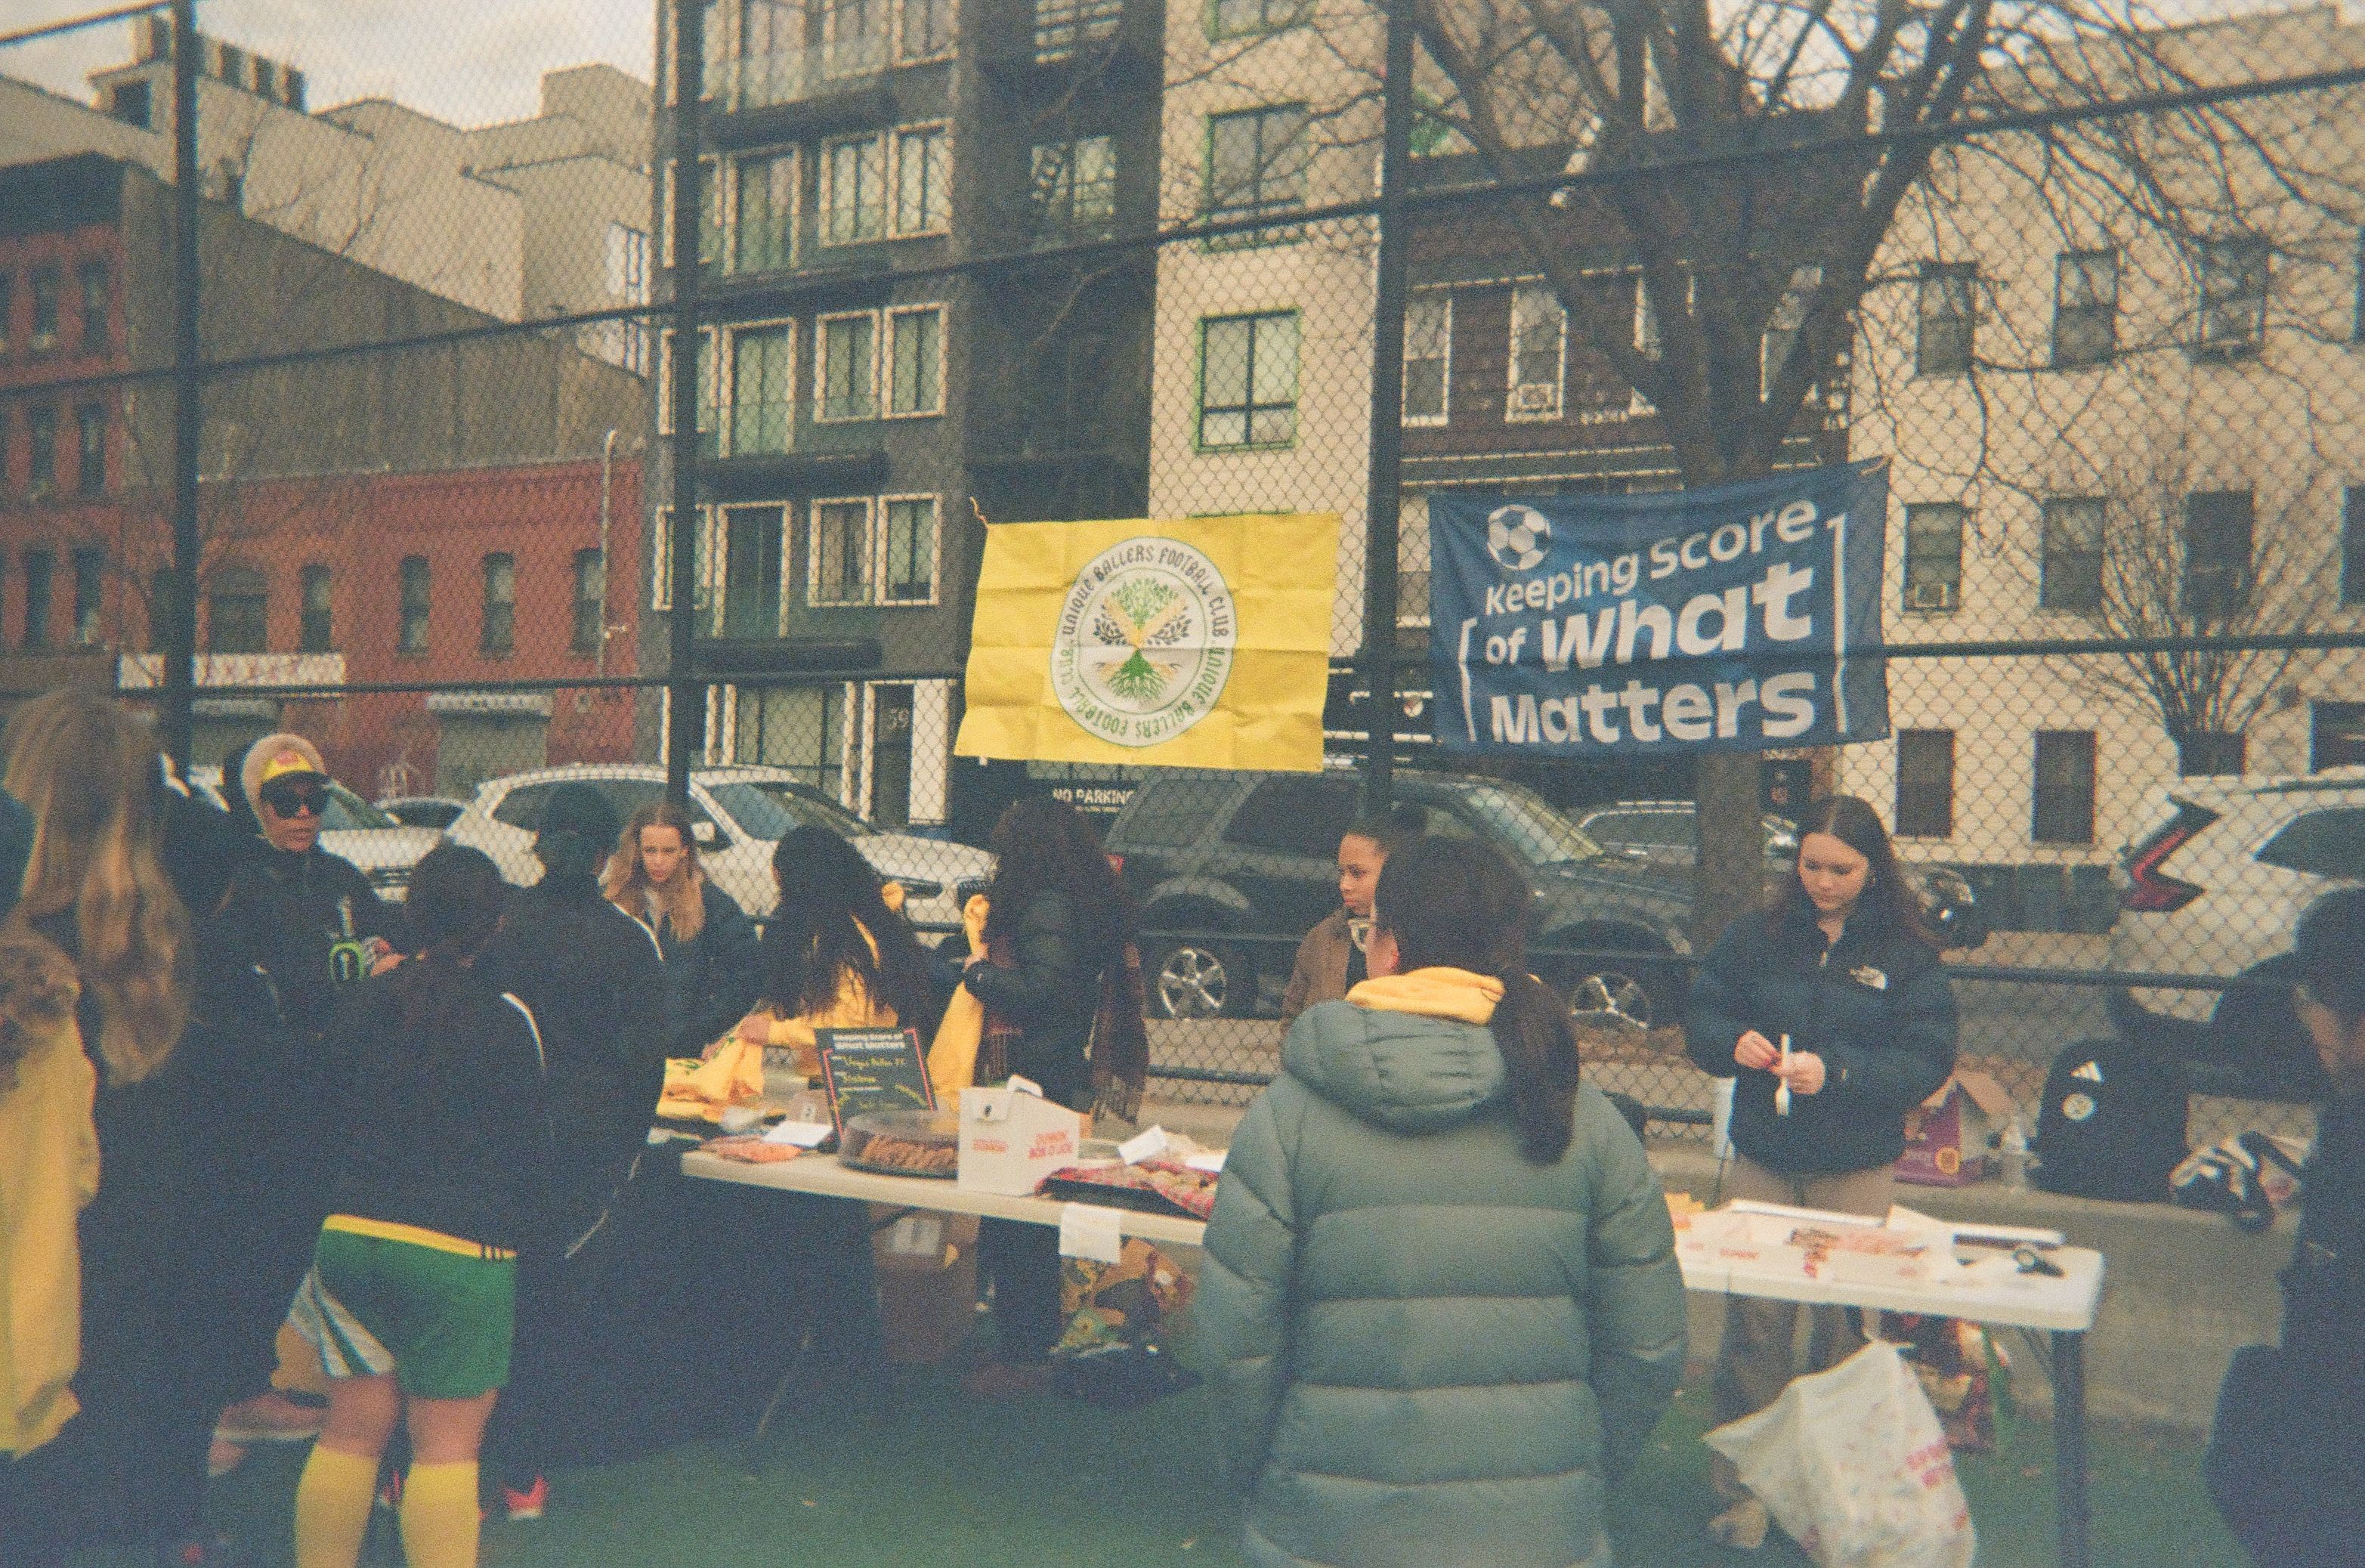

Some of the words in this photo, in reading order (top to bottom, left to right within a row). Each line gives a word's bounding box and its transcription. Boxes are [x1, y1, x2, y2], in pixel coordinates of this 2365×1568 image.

[1093, 544, 1155, 582] BALLERS
[1158, 546, 1214, 595] FOOTBALL
[1209, 595, 1230, 639] CLUB
[1485, 552, 1640, 616] Keeping
[1485, 626, 1526, 665] of
[1069, 686, 1129, 737] FOOTBALL
[1135, 700, 1195, 738] BALLERS
[1491, 671, 1815, 745] Matters
[1053, 787, 1074, 803] NO
